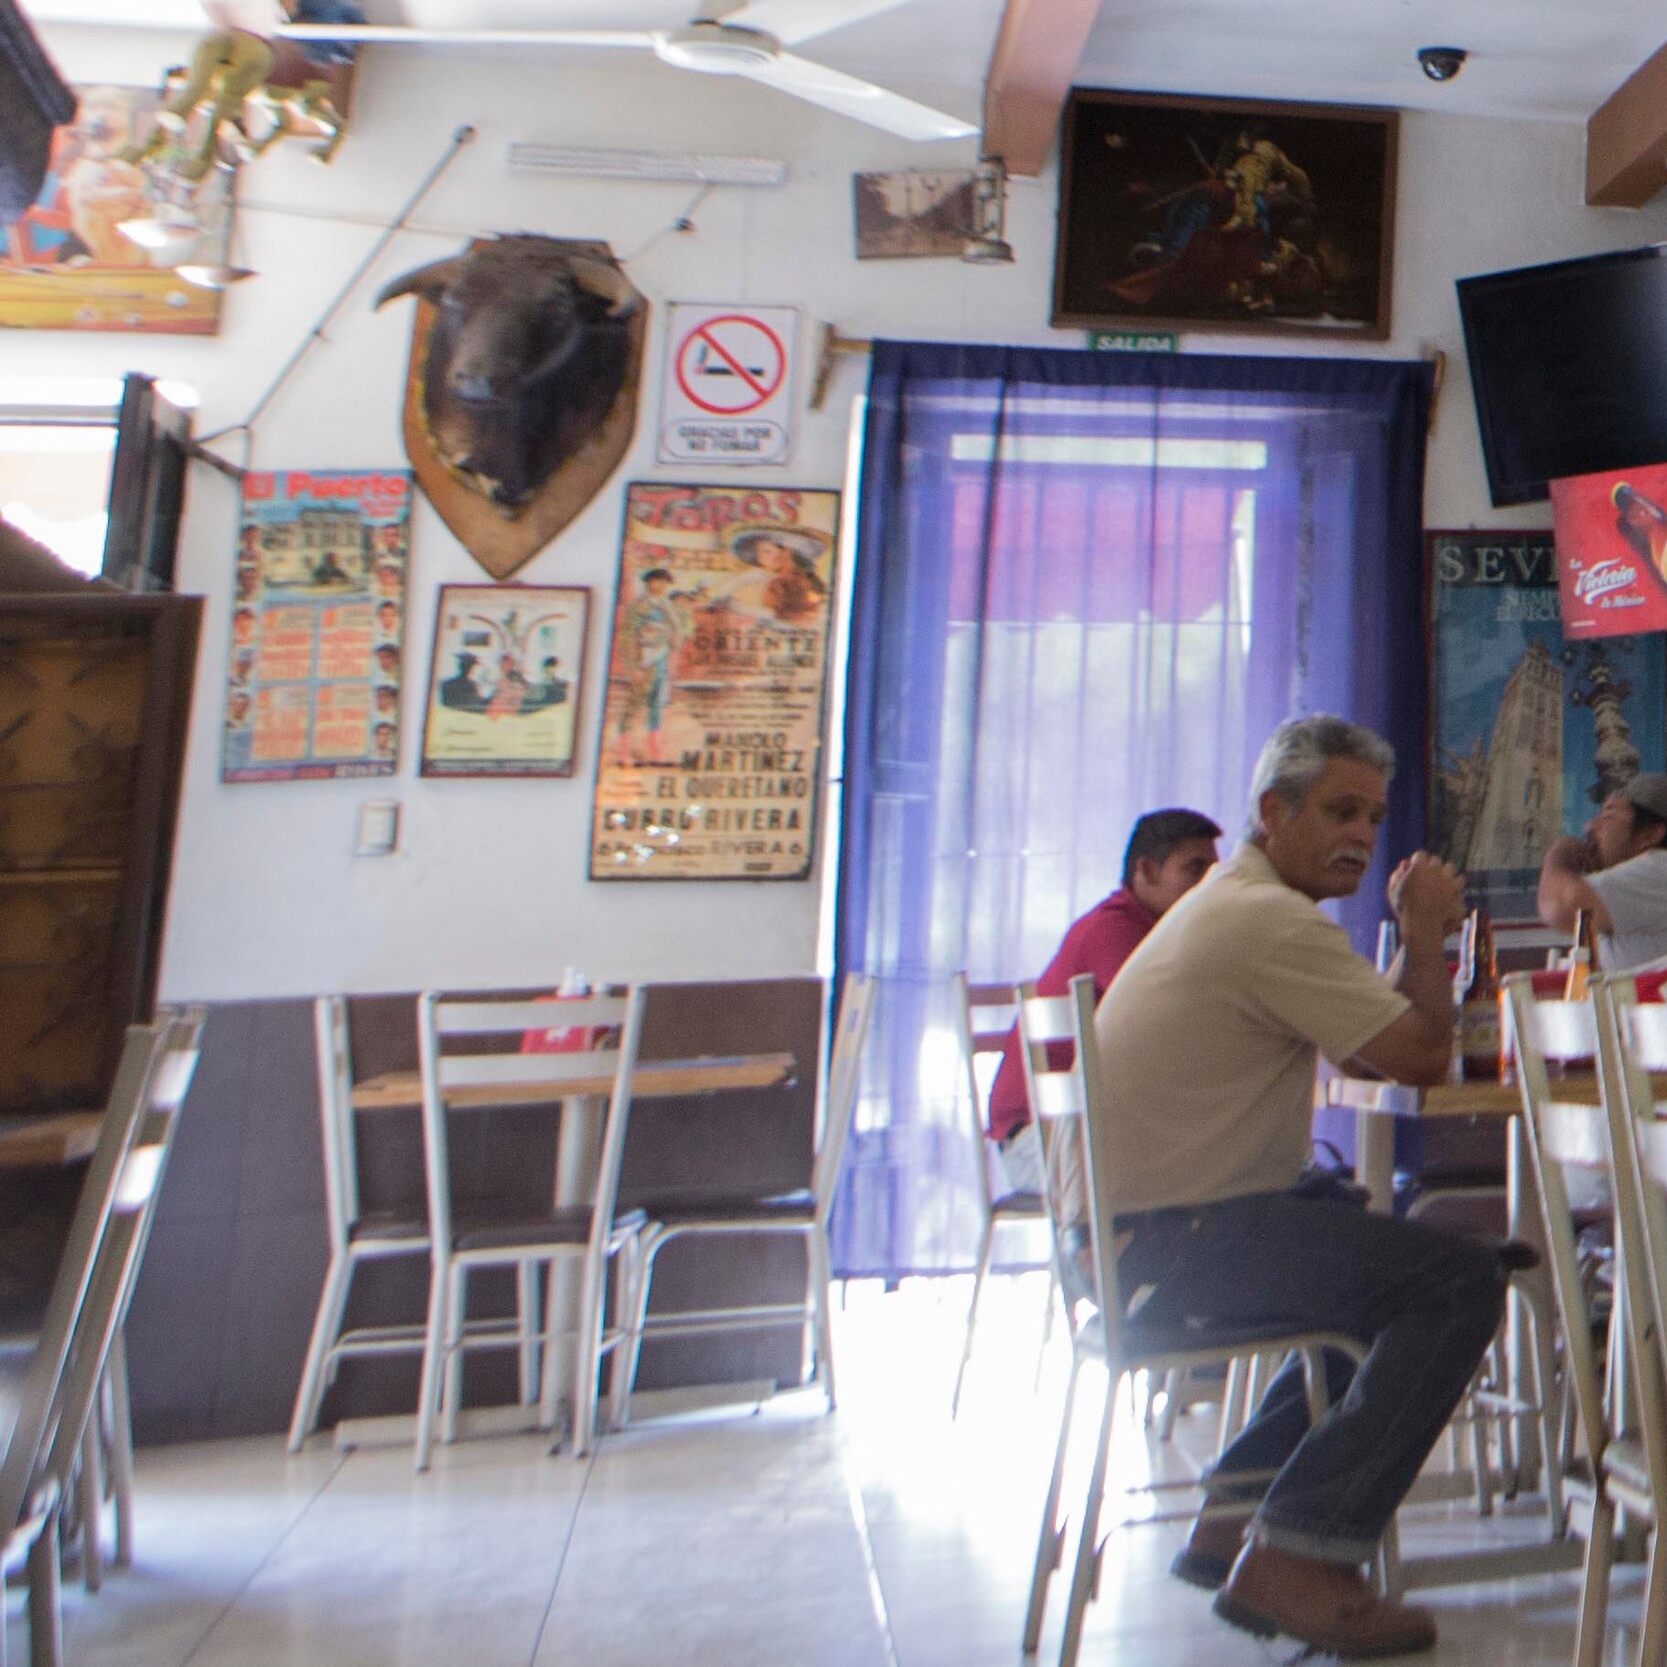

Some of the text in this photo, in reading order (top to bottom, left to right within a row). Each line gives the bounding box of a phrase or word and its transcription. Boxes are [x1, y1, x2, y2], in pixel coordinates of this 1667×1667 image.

[1575, 556, 1637, 606] Victoria
[681, 751, 804, 772] MARTINEZ
[704, 808, 802, 831] RIVERA
